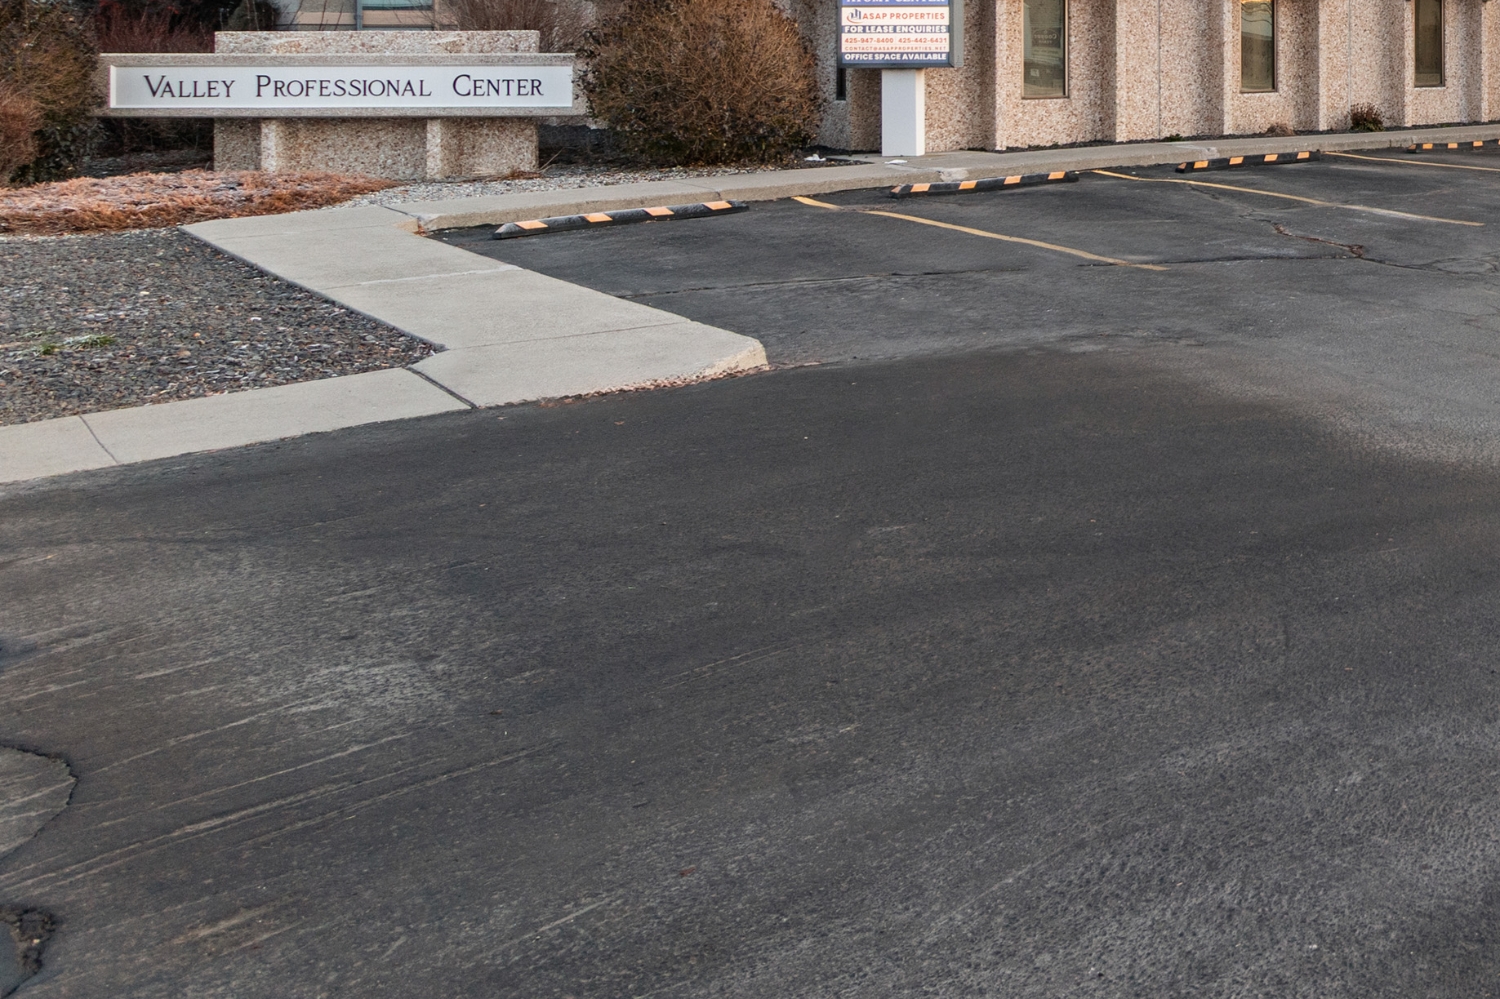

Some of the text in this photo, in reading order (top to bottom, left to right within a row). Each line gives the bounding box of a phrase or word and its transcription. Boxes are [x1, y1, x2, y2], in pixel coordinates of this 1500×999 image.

[844, 53, 874, 61] OFFICE
[874, 53, 901, 61] SPACE
[143, 74, 545, 98] VALLEY PROFESSIONAL CENTER
